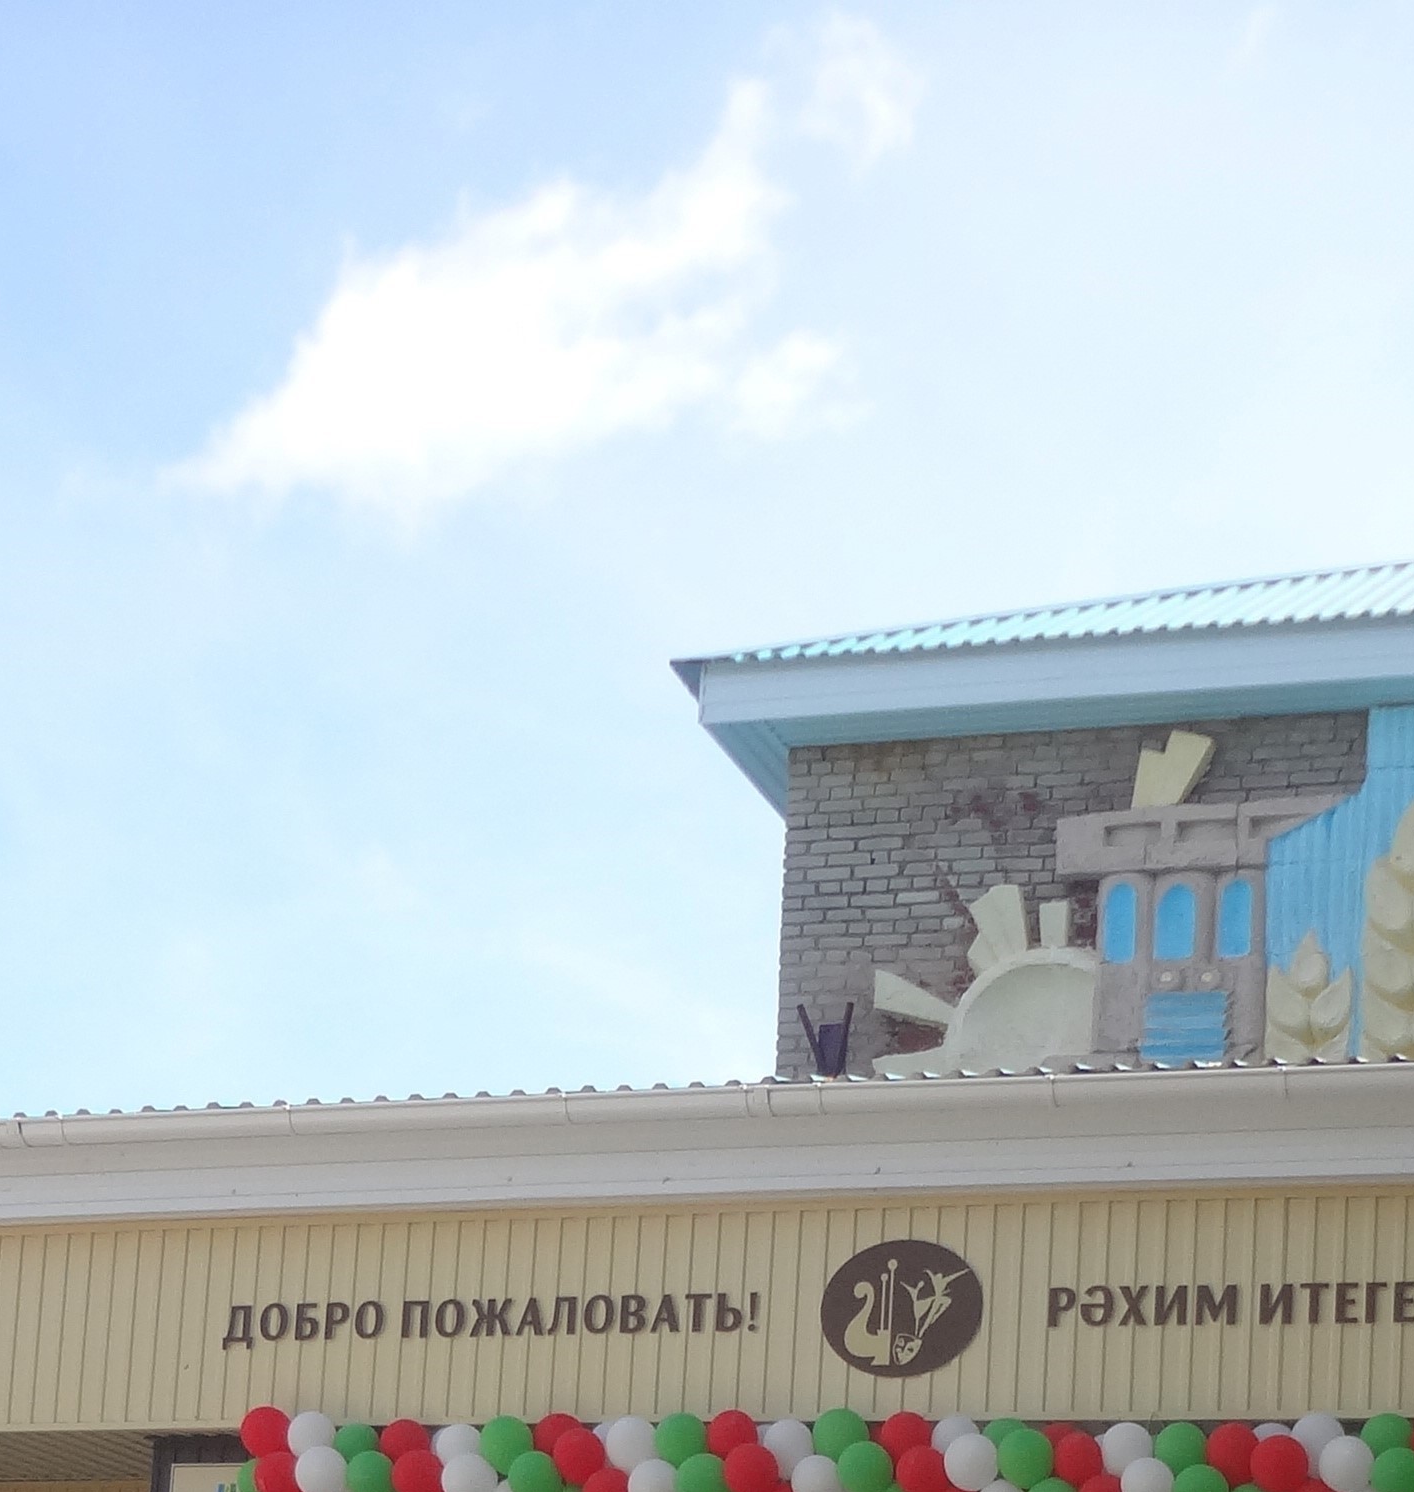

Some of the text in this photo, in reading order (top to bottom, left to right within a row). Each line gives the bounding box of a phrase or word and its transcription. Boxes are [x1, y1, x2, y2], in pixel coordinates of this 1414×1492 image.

[222, 1291, 760, 1350] ДОБРО ПОЖАЛОВАТЬ!
[1046, 1284, 1238, 1328] РӘХИМ
